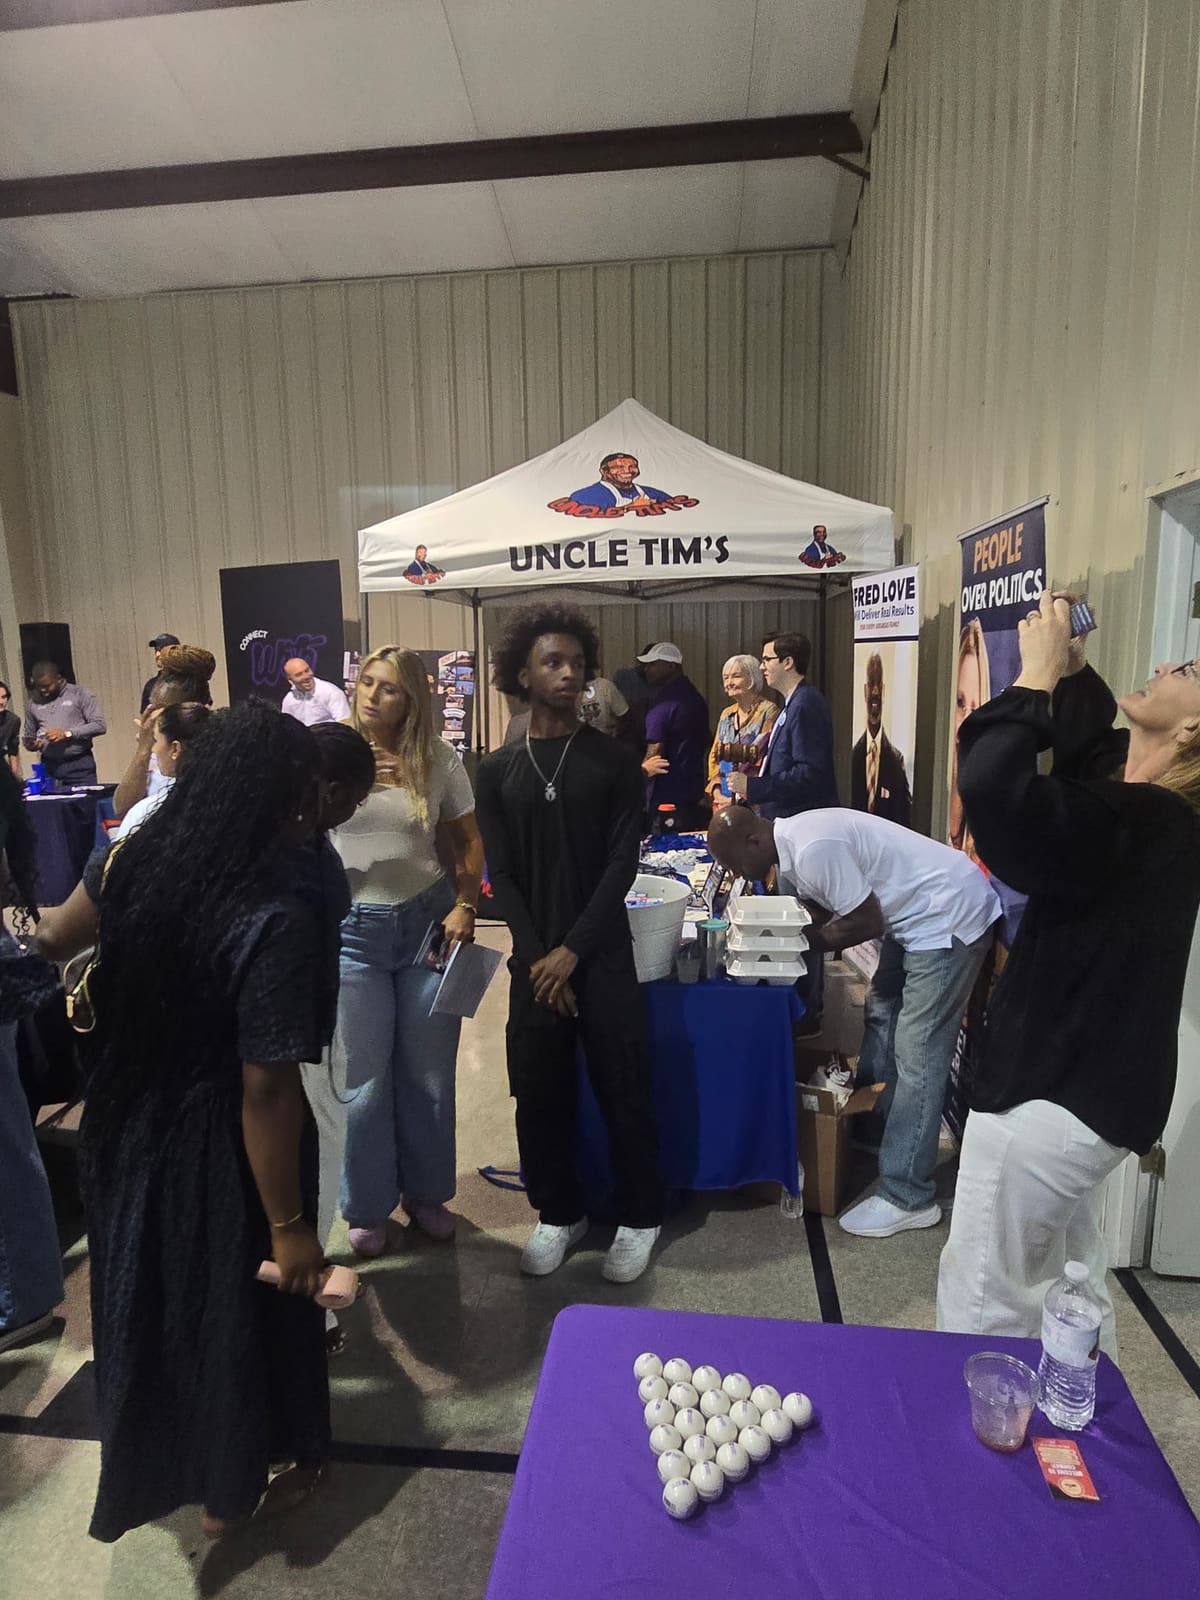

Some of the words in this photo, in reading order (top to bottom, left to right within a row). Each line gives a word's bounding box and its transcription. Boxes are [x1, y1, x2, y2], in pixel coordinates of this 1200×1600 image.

[509, 540, 629, 572] UNCLE
[639, 535, 730, 566] TIM'S
[973, 522, 1024, 575] PEOPLE
[853, 583, 880, 607] FRED
[882, 576, 915, 603] LOVE
[961, 582, 987, 613] OVER
[988, 568, 1043, 609] POLITICS
[861, 607, 881, 620] Deliver
[891, 603, 915, 616] Results
[240, 629, 268, 651] CONNECT
